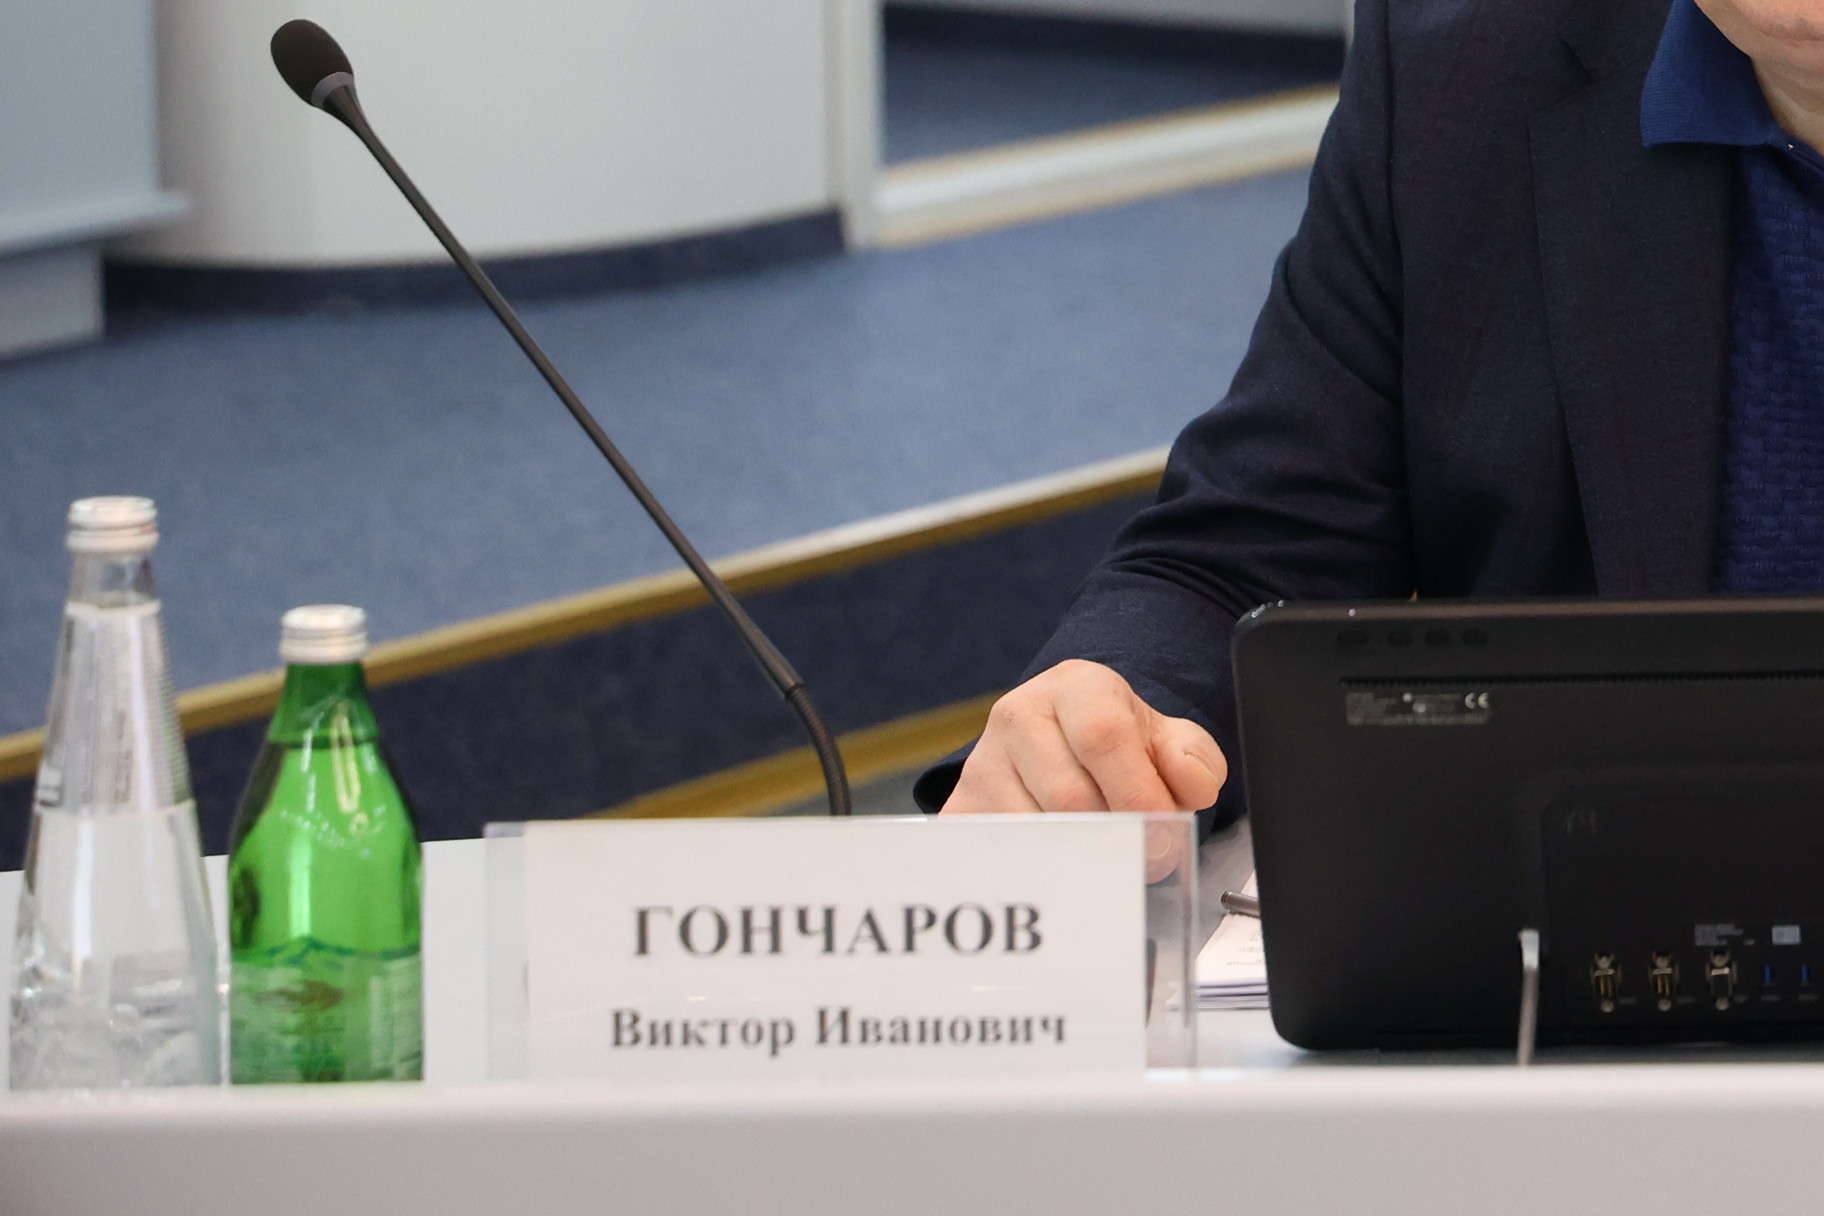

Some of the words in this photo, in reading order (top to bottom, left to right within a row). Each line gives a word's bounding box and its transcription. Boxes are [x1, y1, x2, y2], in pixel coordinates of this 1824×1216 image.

[633, 905, 1043, 956] ГОНЧАРОВ
[611, 1009, 796, 1057] Виктор
[816, 1007, 1067, 1046] Иванович
